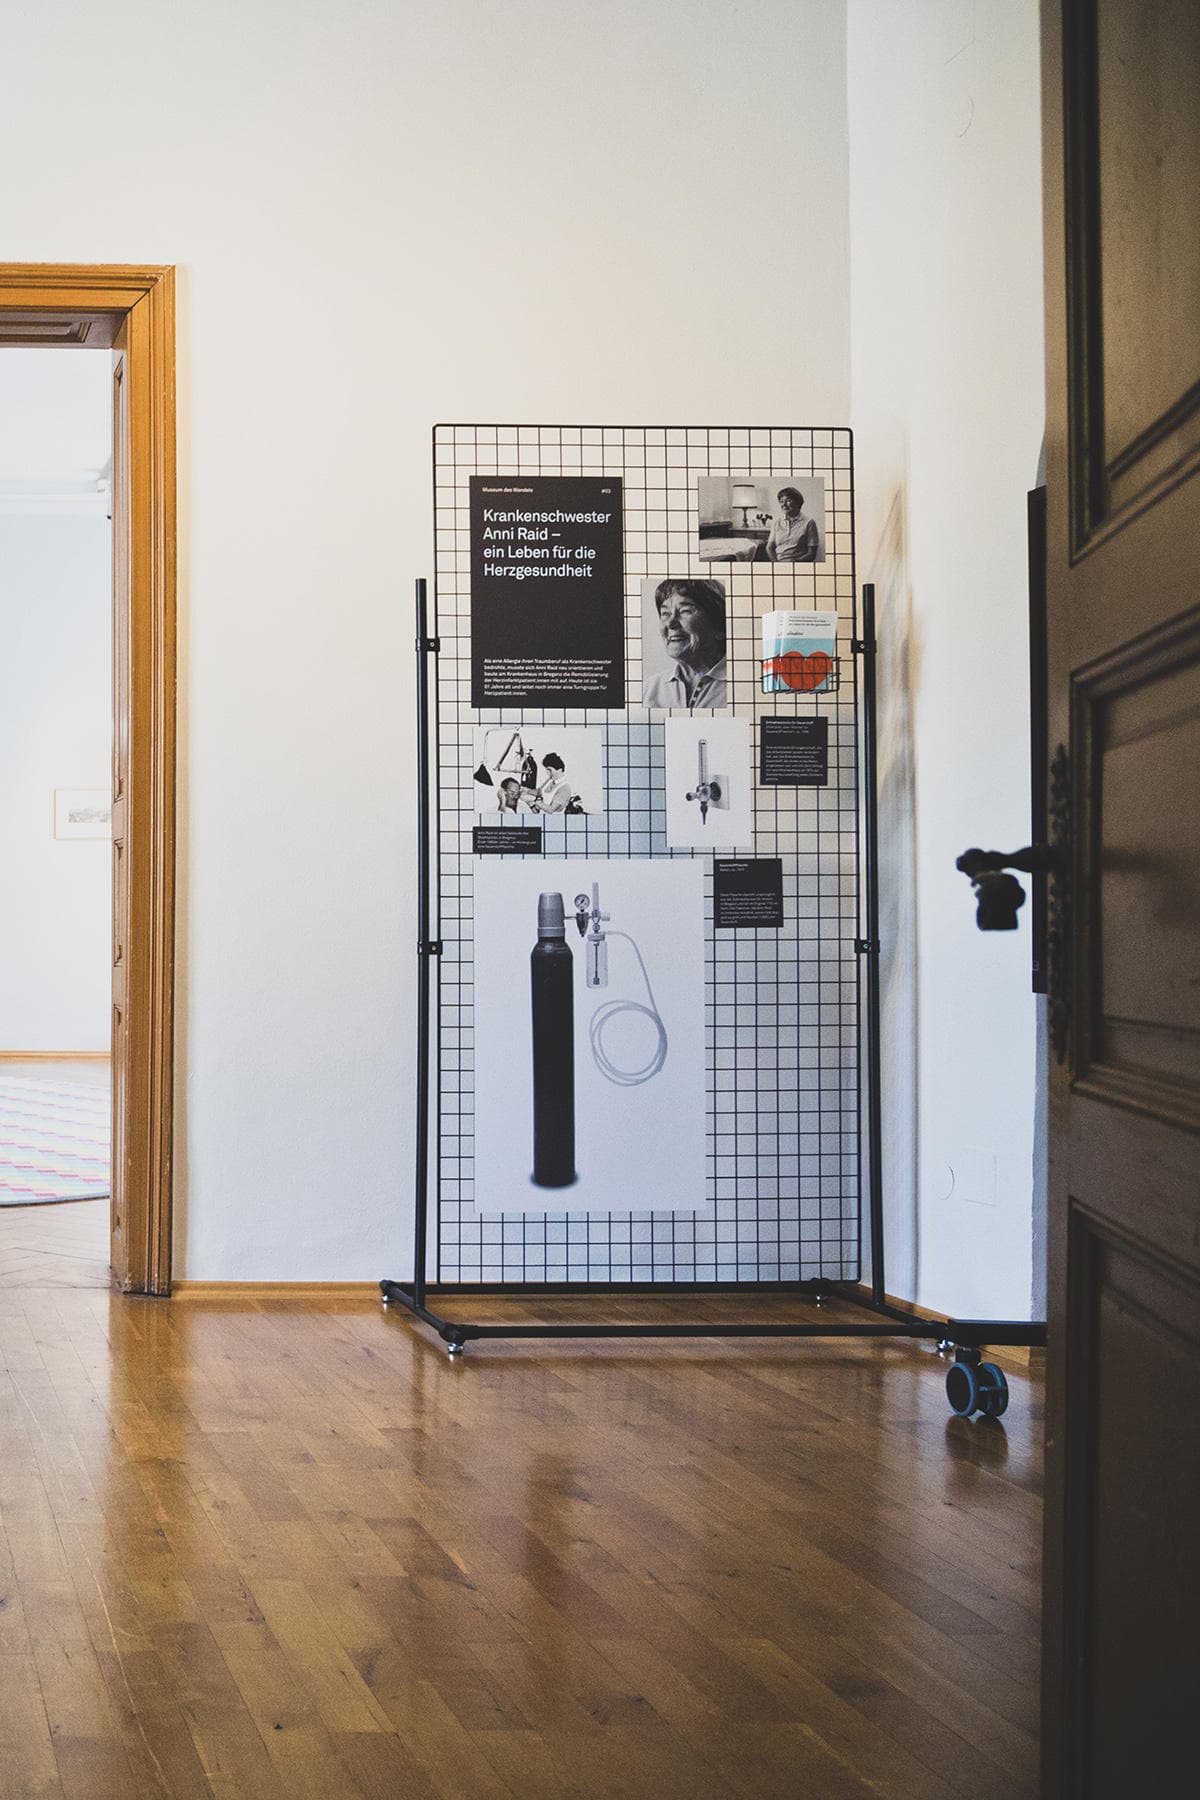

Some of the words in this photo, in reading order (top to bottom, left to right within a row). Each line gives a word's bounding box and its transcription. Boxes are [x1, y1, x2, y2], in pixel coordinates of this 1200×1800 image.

[483, 508, 612, 524] Krankenschwester
[483, 527, 514, 540] Anni
[518, 527, 548, 540] Raid
[483, 545, 504, 558] ein
[508, 545, 550, 558] Leben
[552, 545, 572, 559] für
[575, 546, 596, 559] die
[484, 563, 592, 580] Herzgesundheit
